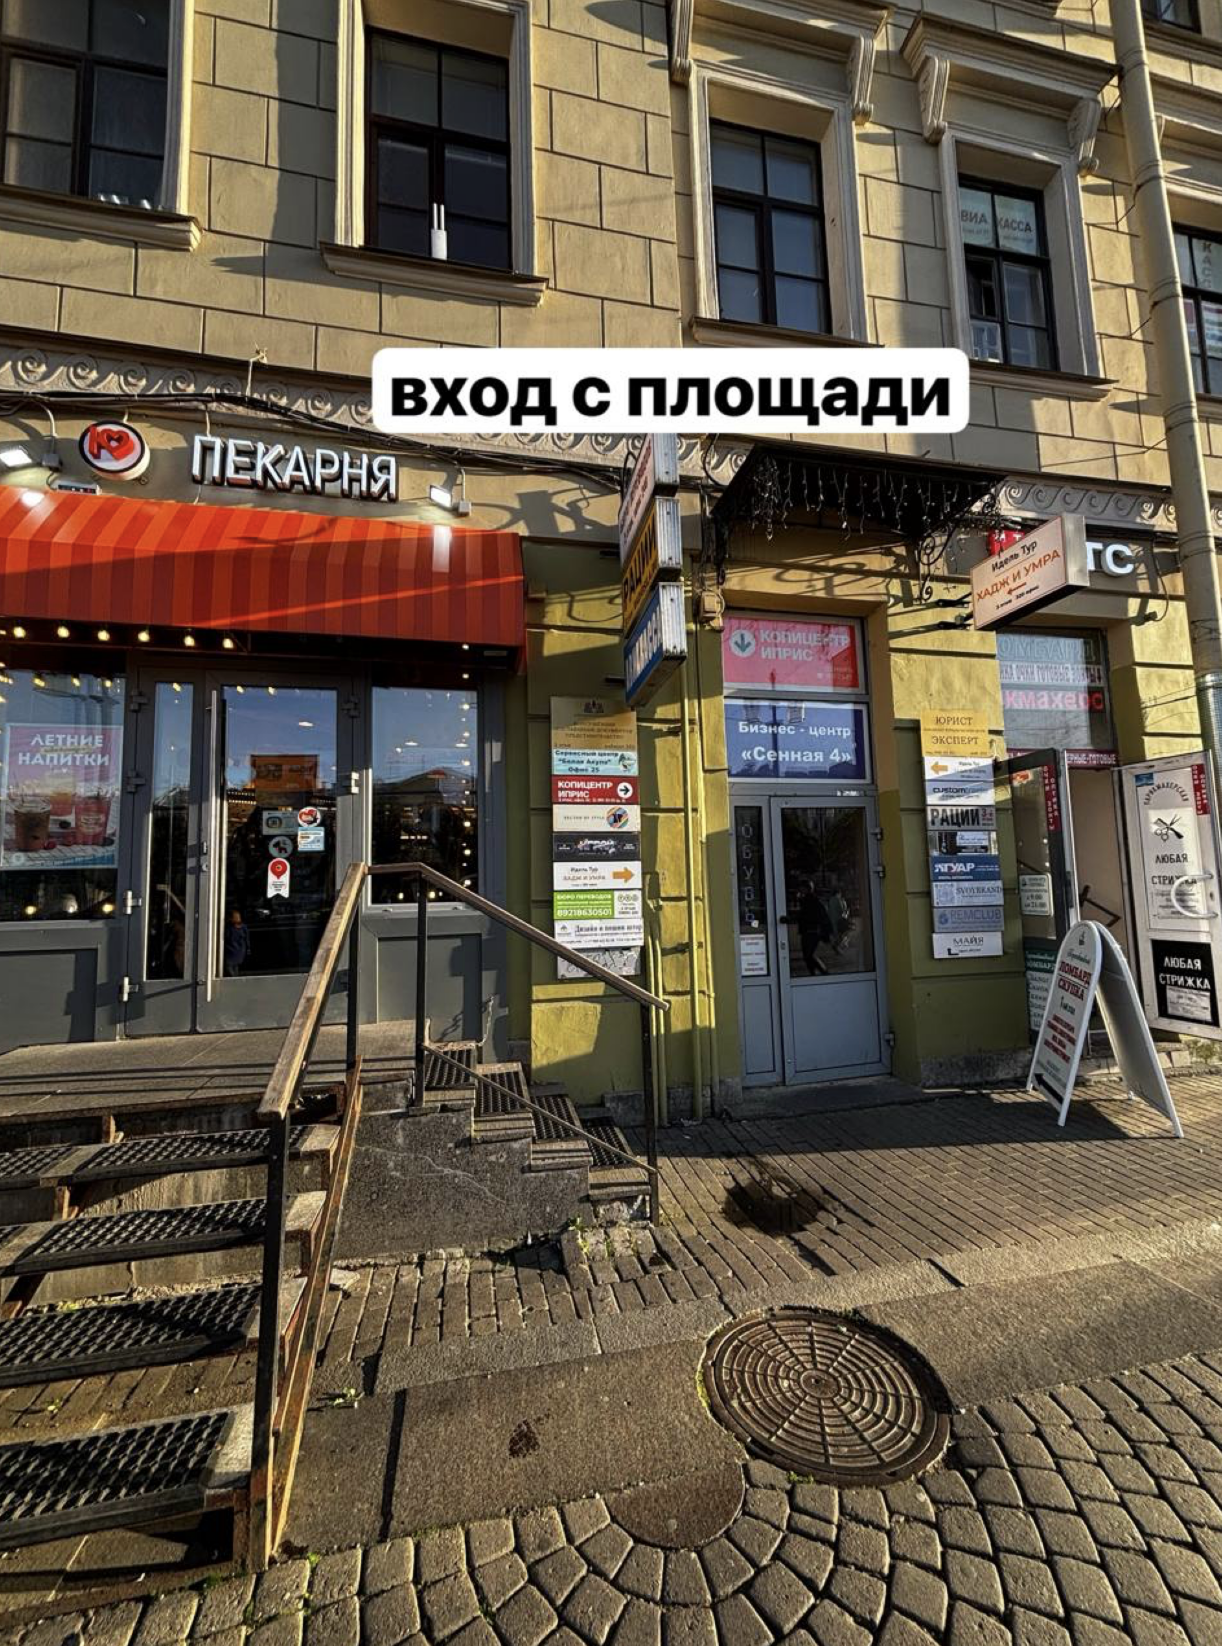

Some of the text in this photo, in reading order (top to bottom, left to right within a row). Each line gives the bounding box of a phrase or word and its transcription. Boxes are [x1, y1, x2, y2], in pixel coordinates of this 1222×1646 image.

[192, 435, 398, 500] ПЕКАРНЯ
[991, 541, 1038, 573] Идель Тур
[976, 549, 1061, 602] ХАДЖ И УМРА
[759, 629, 850, 647] КОПИЦЕНТР
[760, 647, 814, 661] ИПРИС
[935, 716, 974, 726] ЮРИСТ
[738, 721, 796, 735] Бизнес
[809, 726, 851, 739] центр
[31, 733, 104, 748] ЛЕТНИЕ
[932, 735, 979, 745] ЭКСПЕРТ
[18, 752, 110, 766] НАПИТКИ
[741, 746, 851, 763] «Сенная 4»
[557, 780, 614, 789] КОПИЦЕНТР
[557, 790, 590, 798] ИПРИС
[1143, 781, 1190, 806] ПАРИКМАХЕРСКАЯ
[930, 808, 981, 827] РАЦИИ
[1155, 853, 1188, 864] ЛЮБАЯ
[934, 862, 975, 873] ЯГУАР
[953, 935, 984, 945] МАЙЯ
[1163, 956, 1202, 971] ЛЮБАЯ
[1059, 960, 1092, 985] ЛОМБАРД
[1057, 976, 1085, 1001] СКУПКА
[1158, 972, 1212, 990] СТРИЖКА
